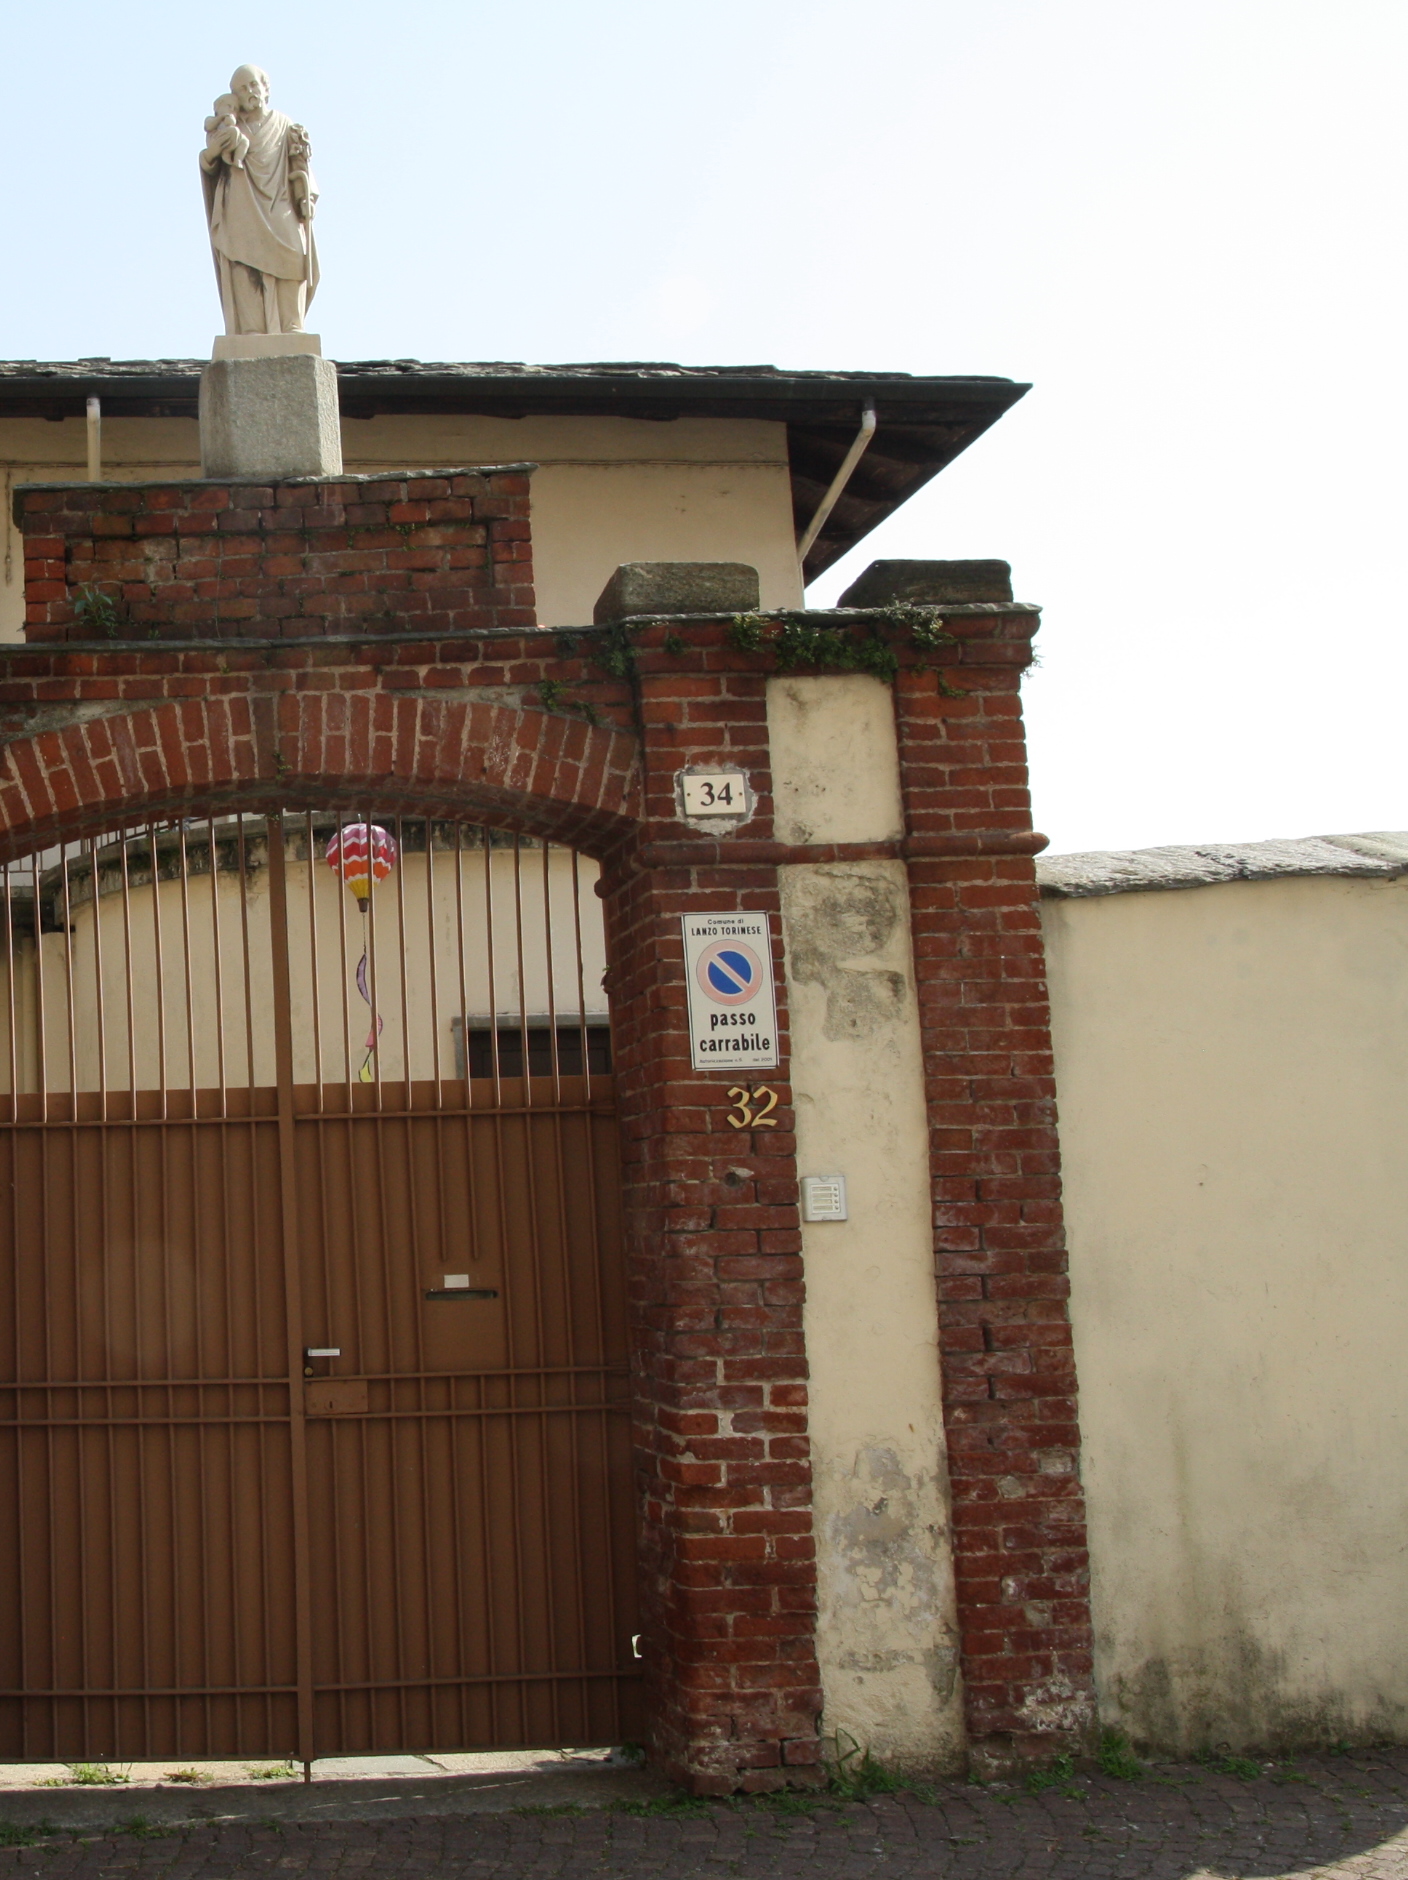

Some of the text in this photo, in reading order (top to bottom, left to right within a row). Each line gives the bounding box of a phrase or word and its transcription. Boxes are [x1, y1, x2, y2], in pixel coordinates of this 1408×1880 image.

[700, 782, 733, 806] 34
[691, 926, 762, 936] LANZO TORINESE
[710, 1012, 756, 1031] passo
[699, 1033, 770, 1052] carrabile
[726, 1085, 779, 1129] 32
